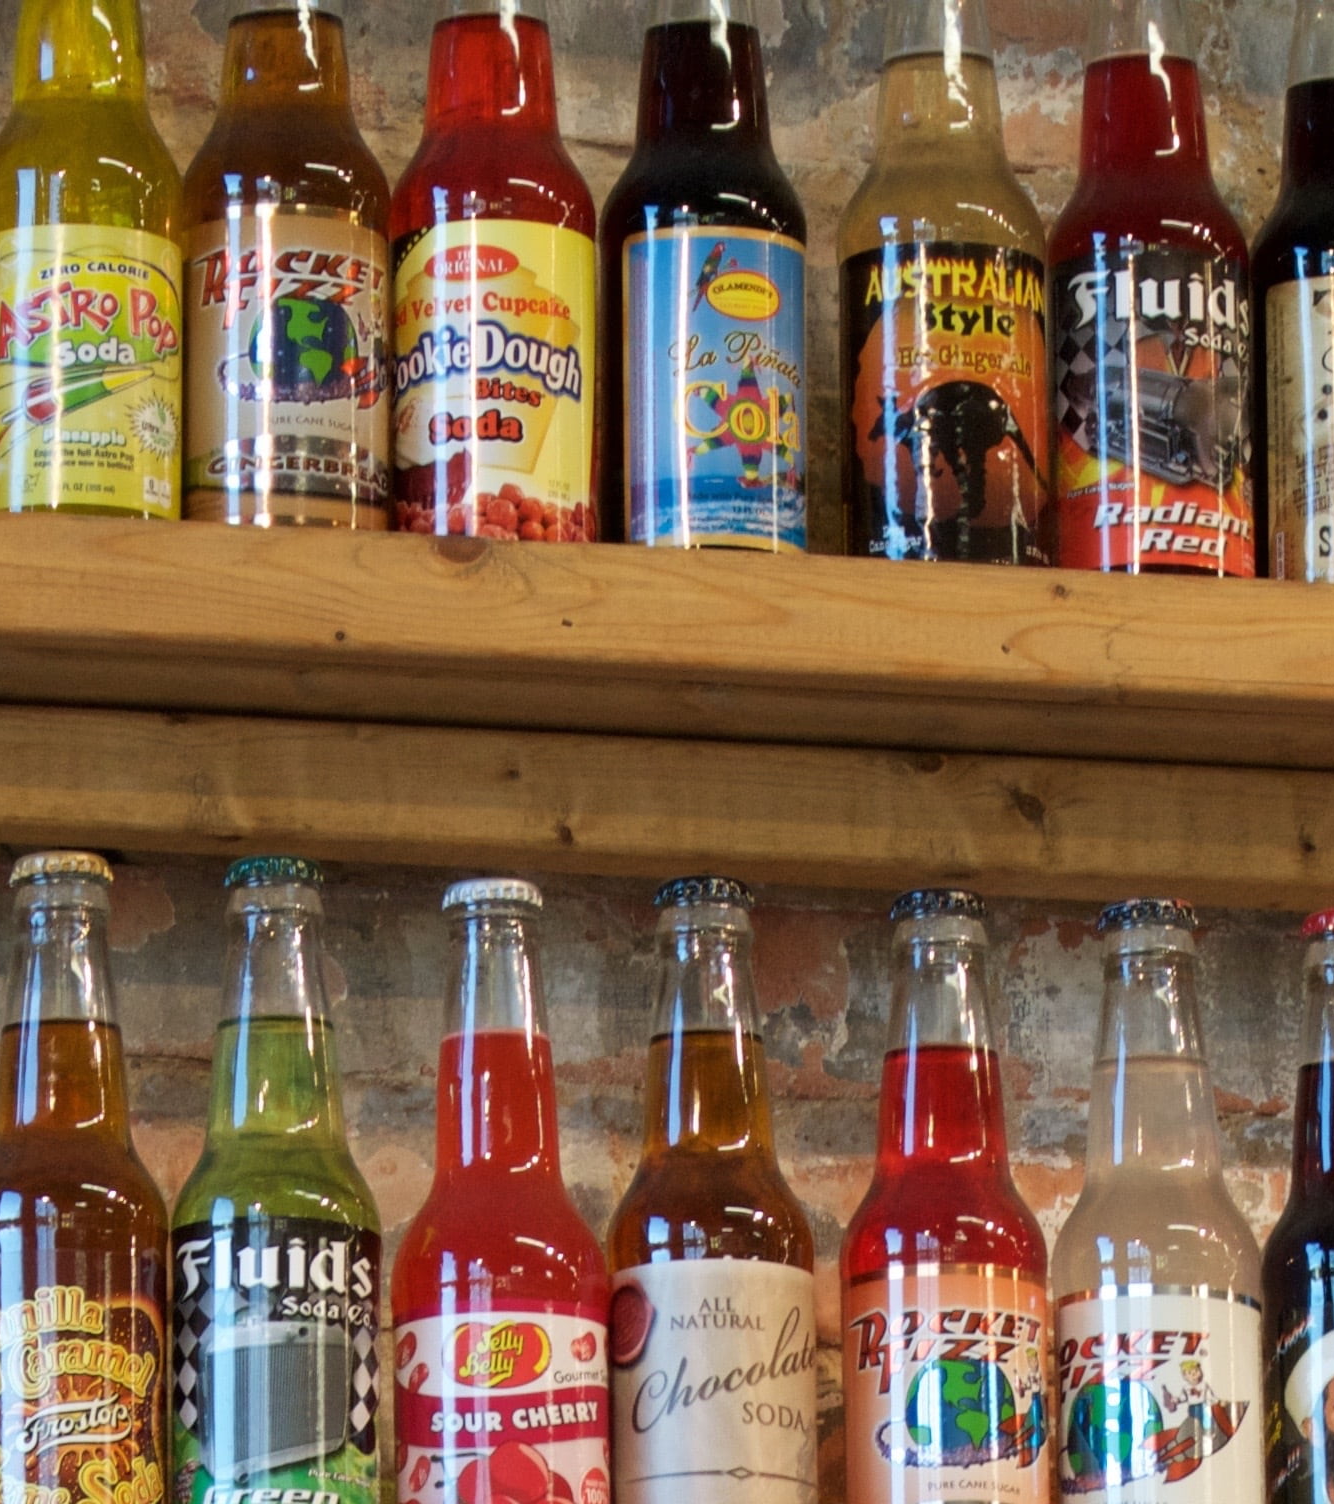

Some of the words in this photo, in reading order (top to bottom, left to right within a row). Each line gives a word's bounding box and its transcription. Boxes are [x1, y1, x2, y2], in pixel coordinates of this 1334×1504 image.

[87, 262, 150, 280] CALORIE
[413, 296, 475, 316] Velvet
[480, 296, 571, 320] Cupcake
[56, 340, 136, 367] Soda
[429, 411, 522, 444] Soda
[177, 1236, 374, 1295] Fluids
[699, 1298, 736, 1313] ALL
[669, 1314, 765, 1333] NATURAL
[475, 1328, 524, 1355] Jelly
[10, 1333, 154, 1398] Caramel
[460, 1351, 516, 1381] Belly
[430, 1409, 503, 1434] SOUR
[511, 1402, 599, 1429] CHERRY
